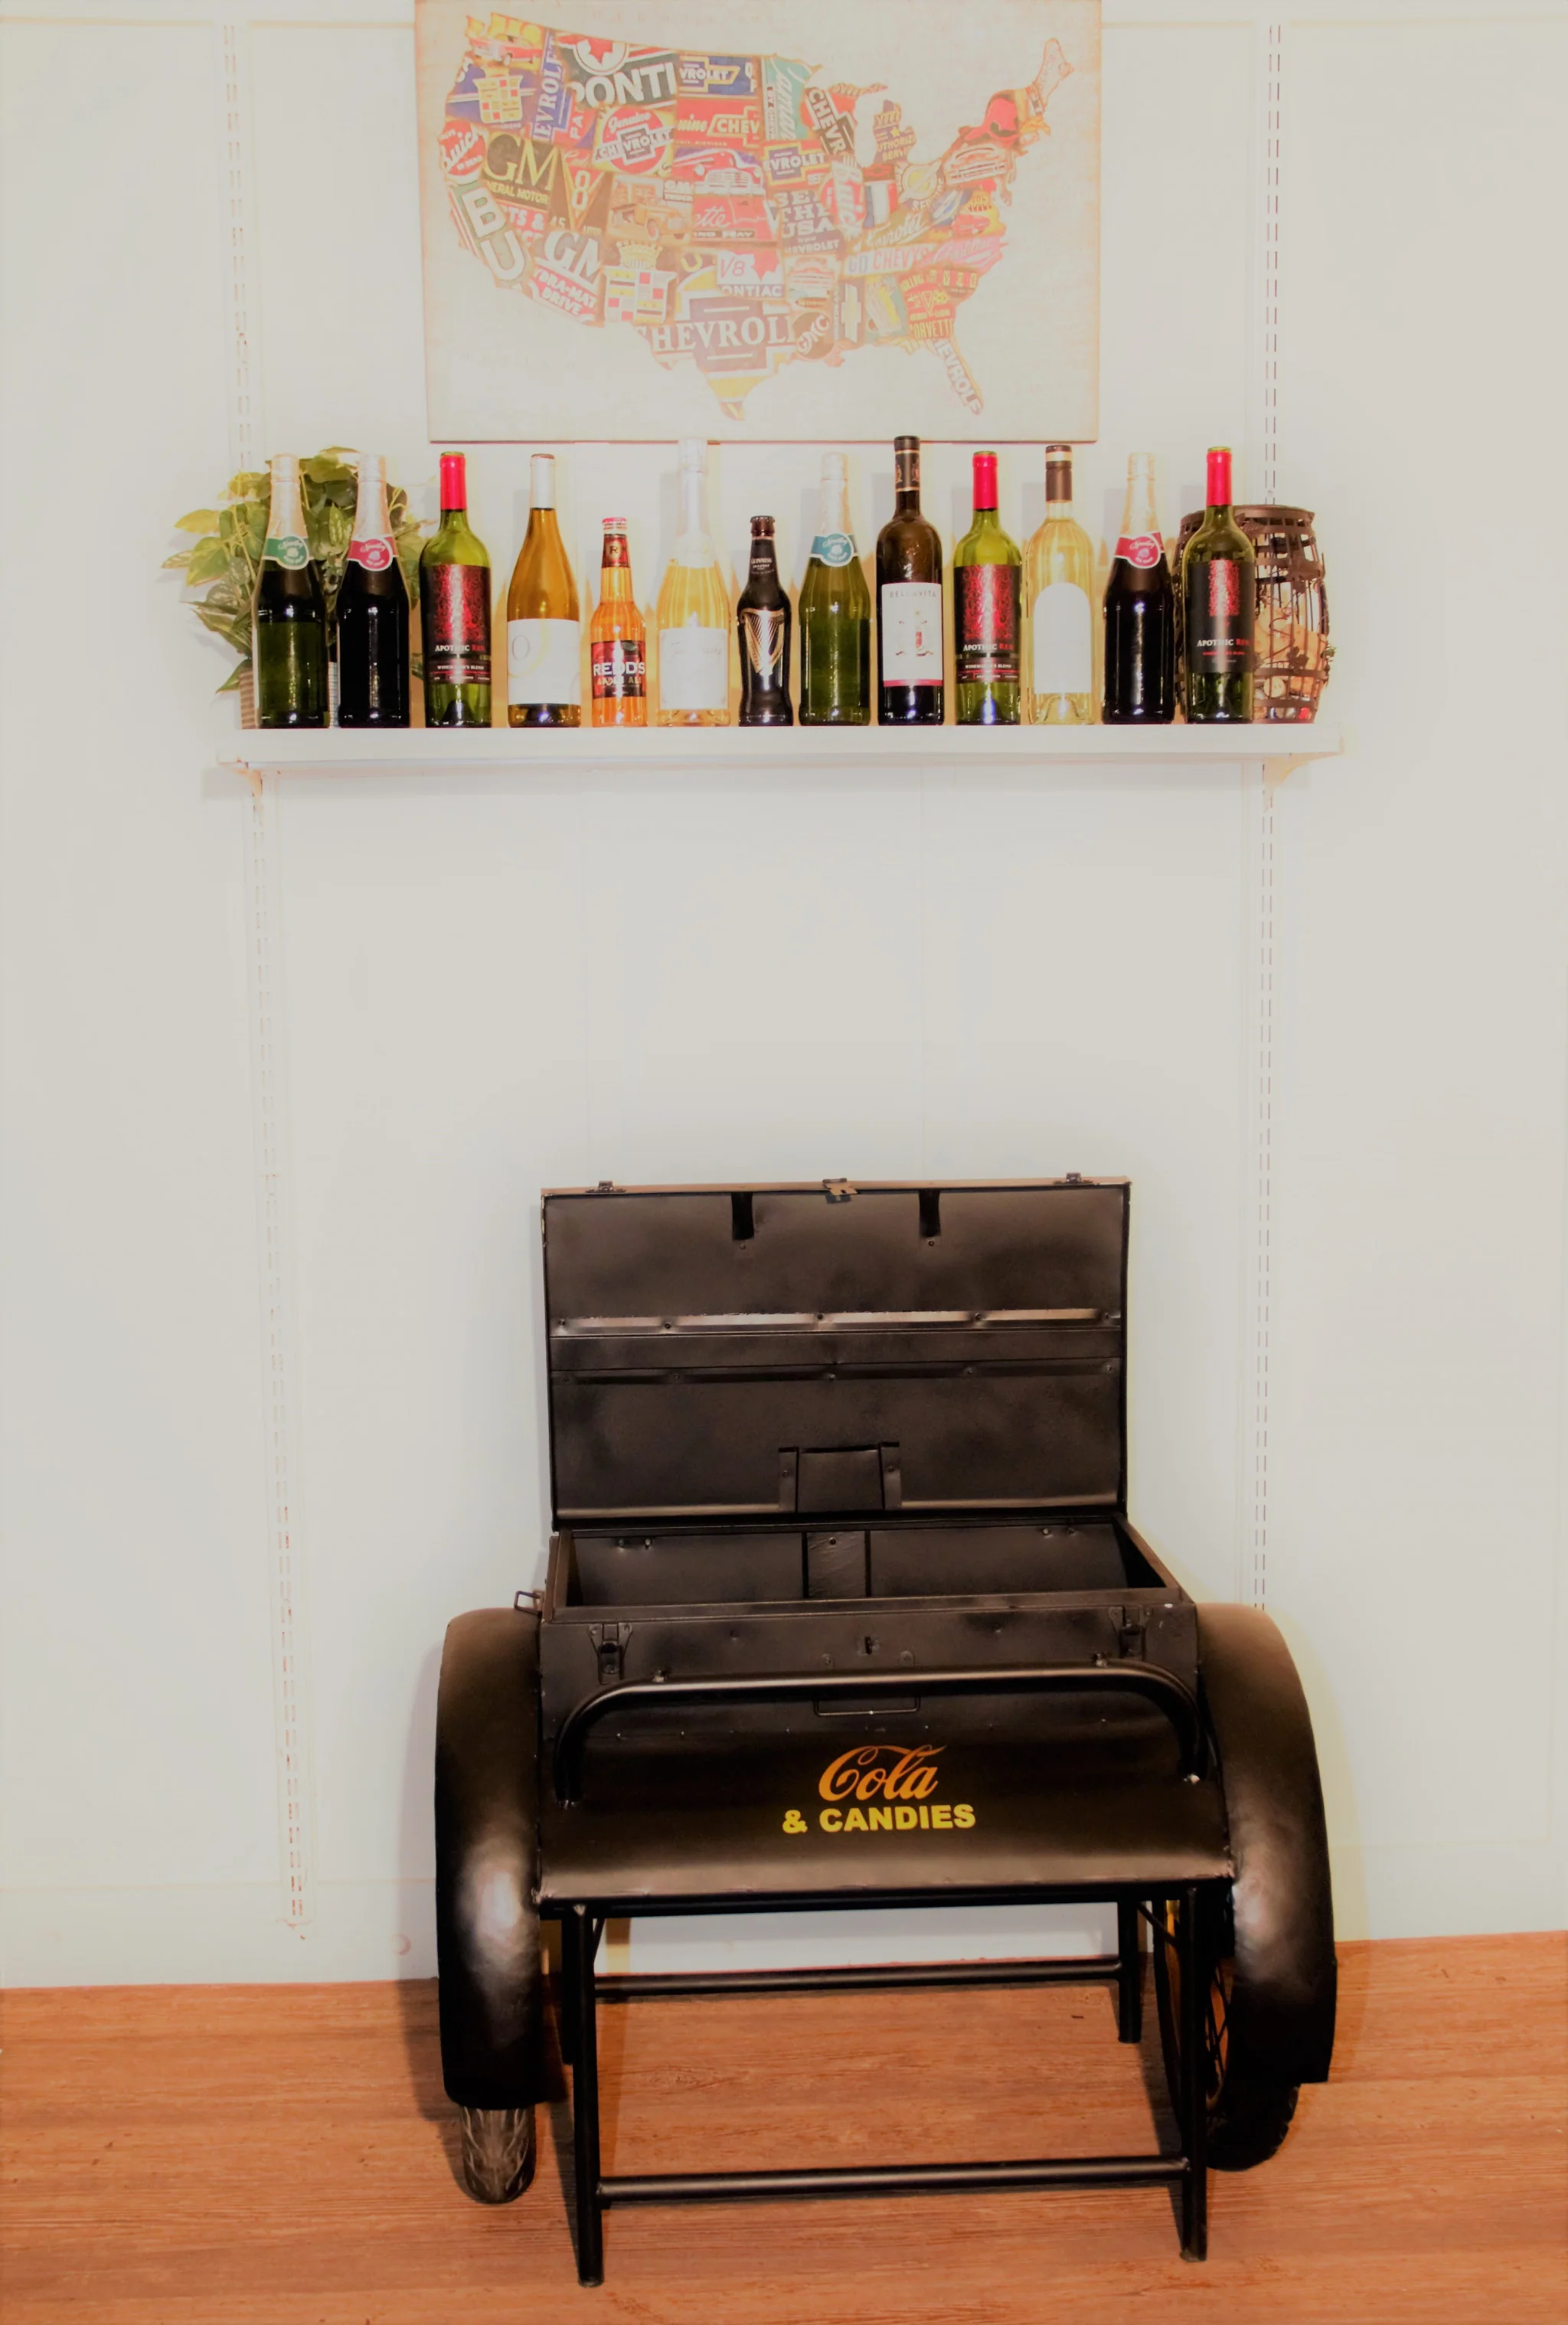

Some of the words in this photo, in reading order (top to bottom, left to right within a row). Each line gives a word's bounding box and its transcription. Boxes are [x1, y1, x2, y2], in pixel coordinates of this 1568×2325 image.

[818, 1745, 947, 1802] Cola
[782, 1810, 808, 1834] &
[818, 1803, 976, 1833] CANDIES
